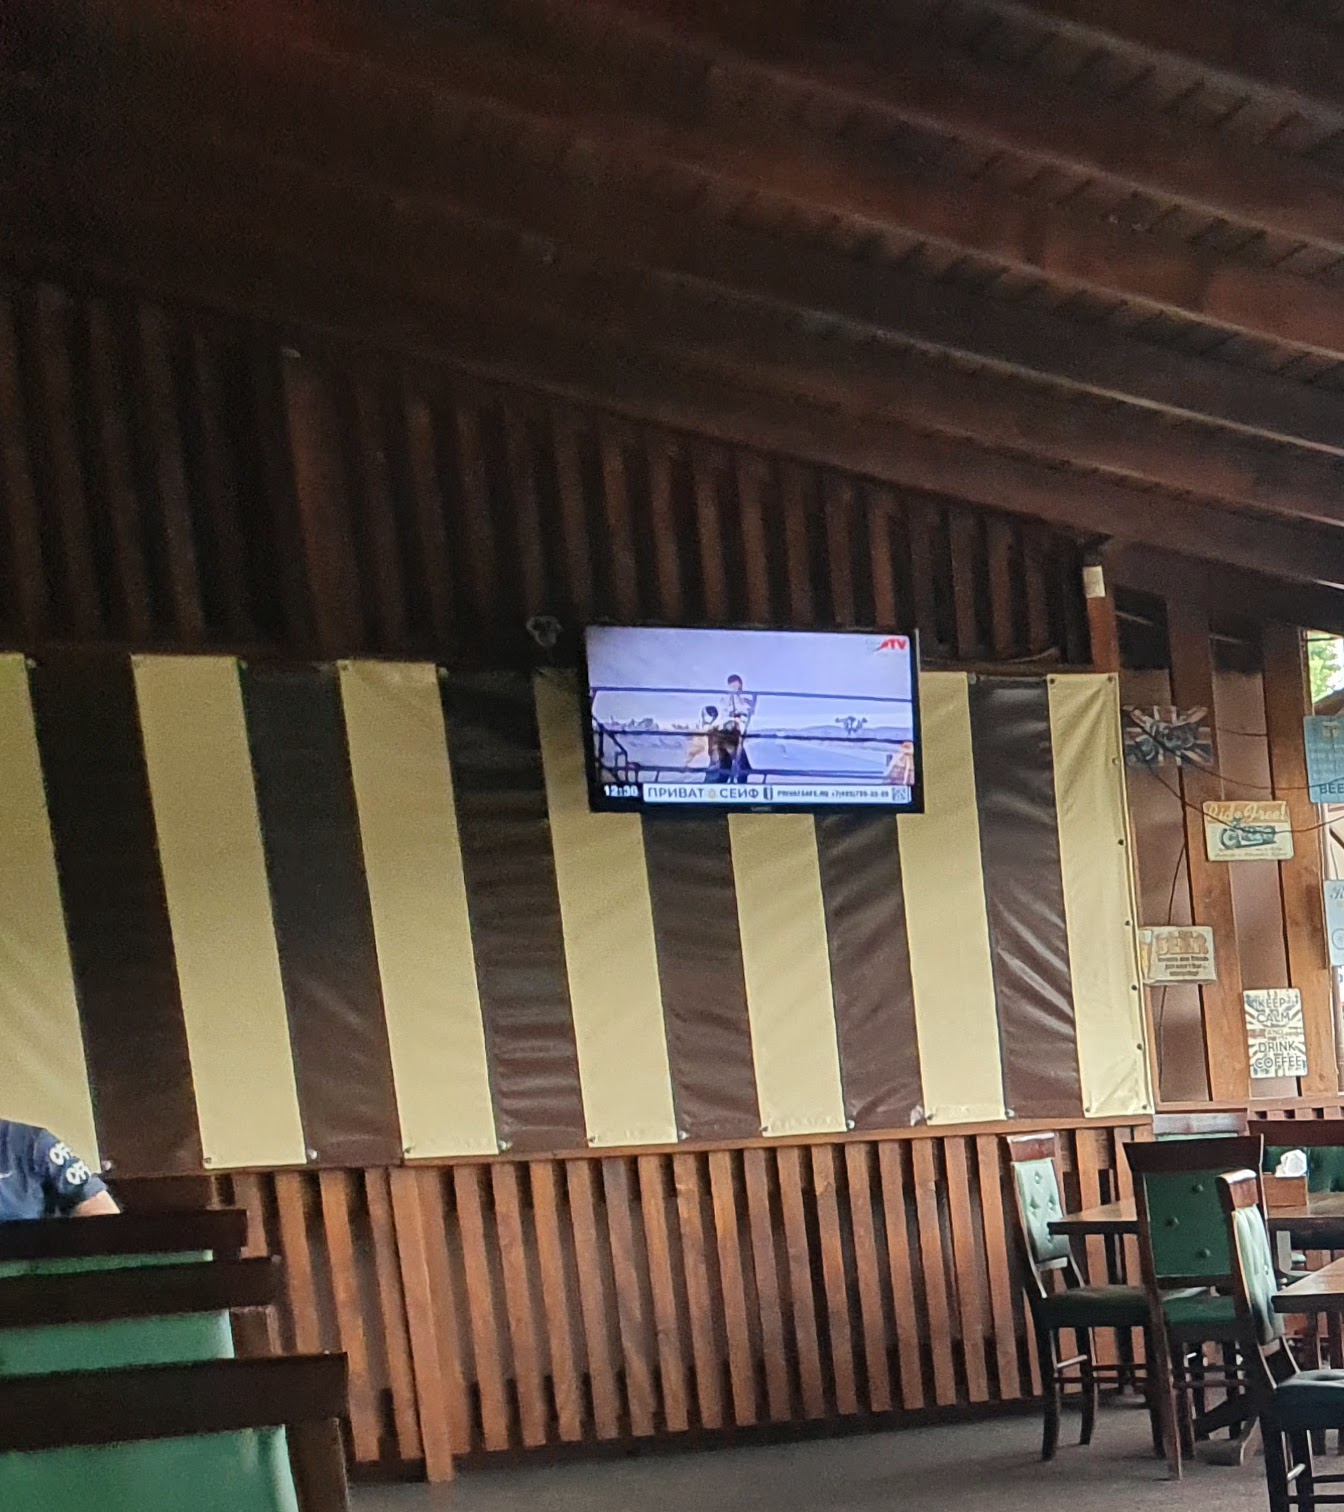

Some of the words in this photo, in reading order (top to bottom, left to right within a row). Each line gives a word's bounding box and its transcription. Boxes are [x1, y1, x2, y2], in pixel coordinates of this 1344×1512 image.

[647, 786, 704, 799] ПРИВАТ
[1257, 997, 1286, 1009] KEEP
[1256, 1011, 1290, 1023] CALM
[1267, 1028, 1284, 1036] AND
[1258, 1041, 1296, 1053] DRINK
[1254, 1056, 1302, 1069] COFFEE
